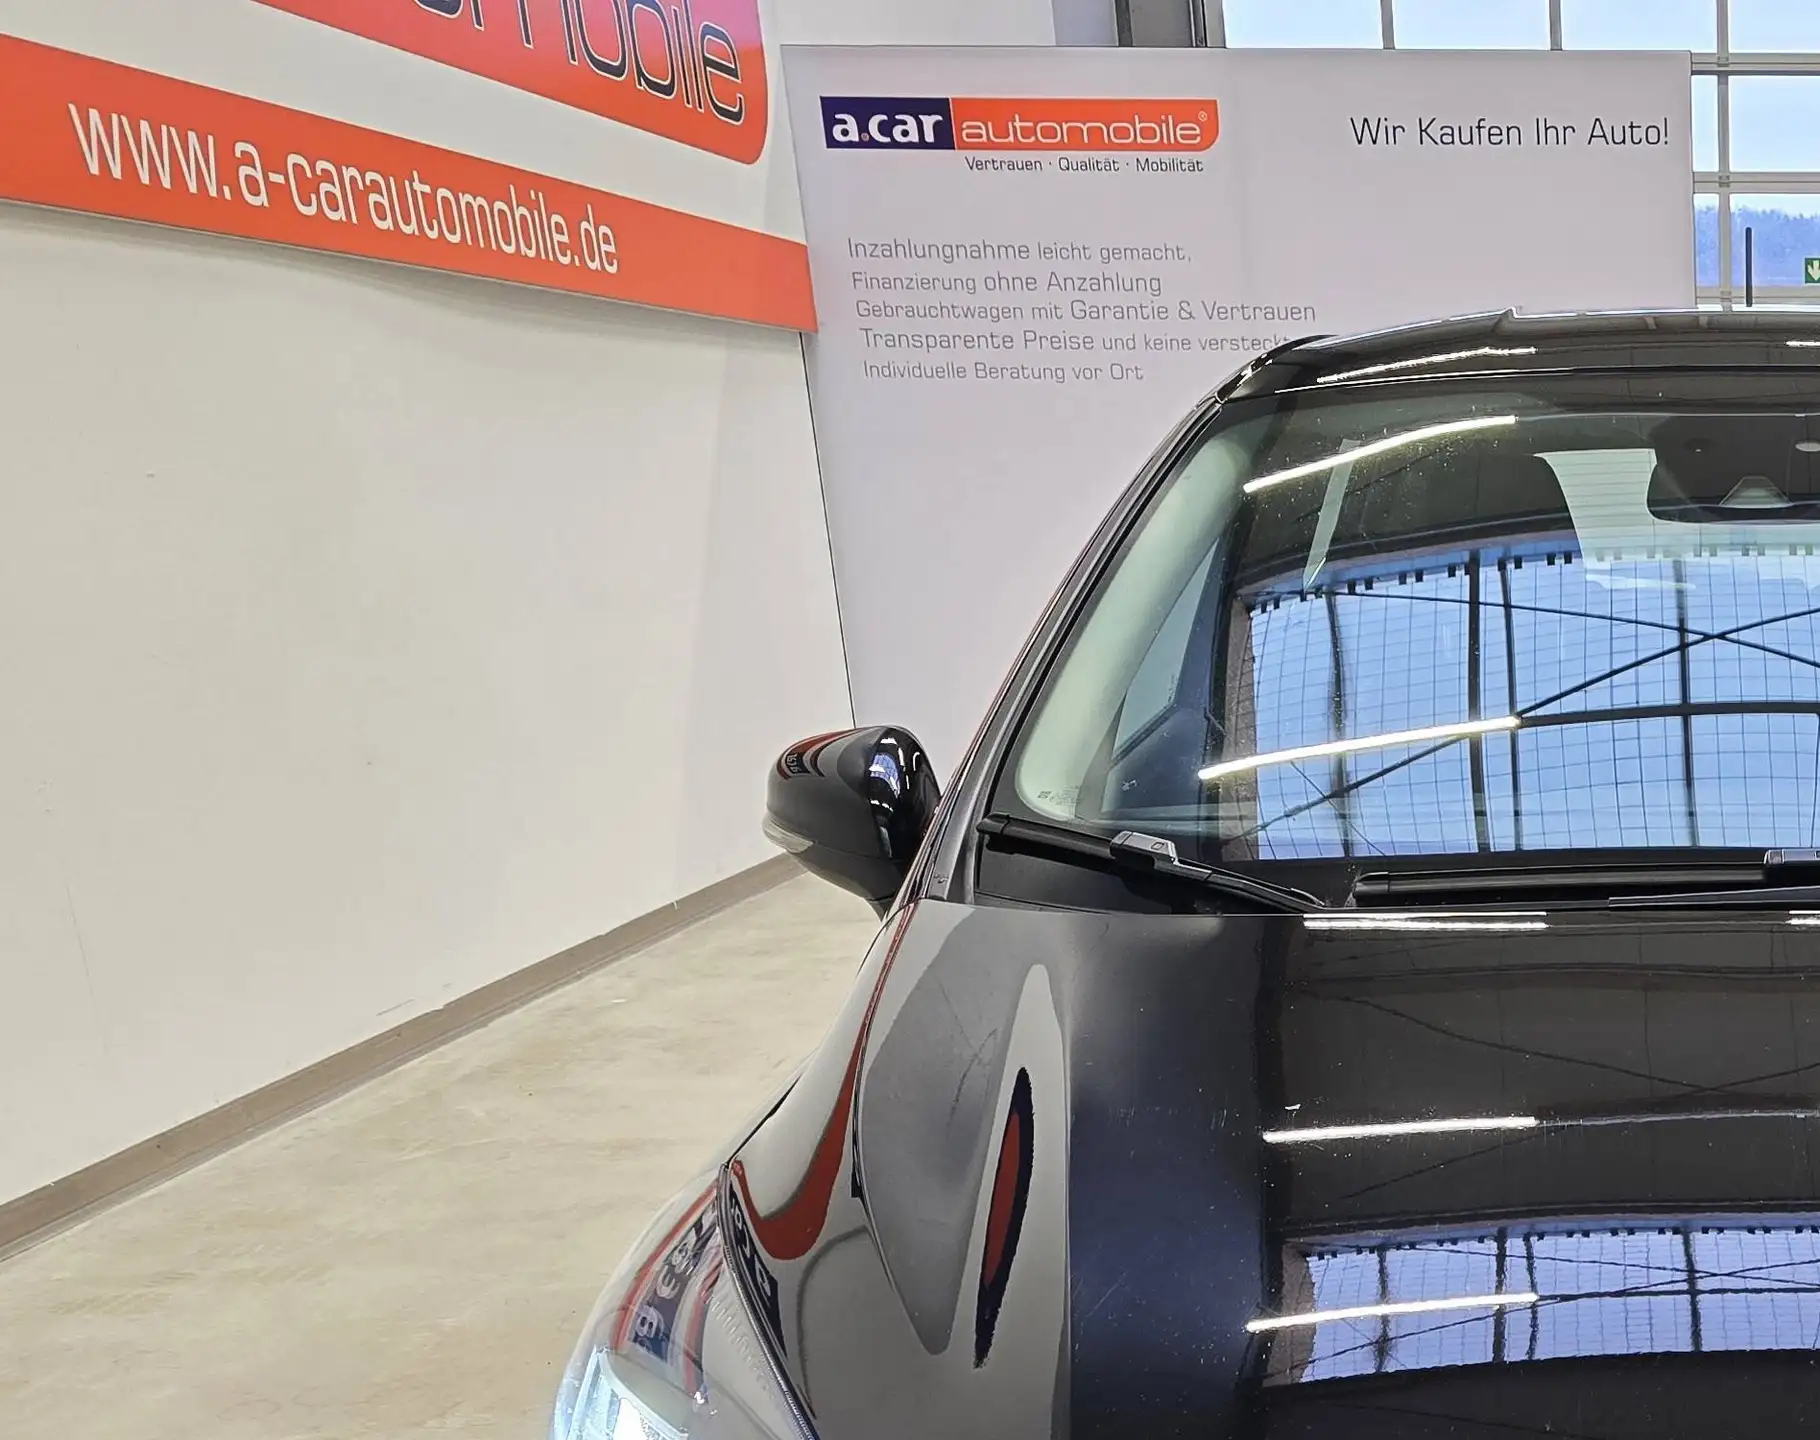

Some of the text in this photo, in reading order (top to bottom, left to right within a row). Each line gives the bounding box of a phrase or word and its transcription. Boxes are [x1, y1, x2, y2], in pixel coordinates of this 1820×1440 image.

[831, 111, 944, 145] a.car
[1349, 116, 1669, 146] Wir Kaufen Ihr Auto!
[964, 155, 1204, 173] Vertrauen Qualität Mobilität
[67, 102, 620, 275] www.a-carautomobile.de
[847, 237, 1030, 263] Inzahlungnahme
[1037, 241, 1092, 261] leicht
[851, 270, 1162, 298] Finanzierung ohne Anzahlung
[855, 299, 1316, 324] Gebrauchtwagen mit Garantie & Vertrauen
[858, 327, 1015, 352] Transparente
[1023, 329, 1095, 351] Preise
[1102, 332, 1137, 351] und
[1143, 333, 1192, 351] keine
[863, 359, 1144, 384] Individuelle Beratung vor Ort
